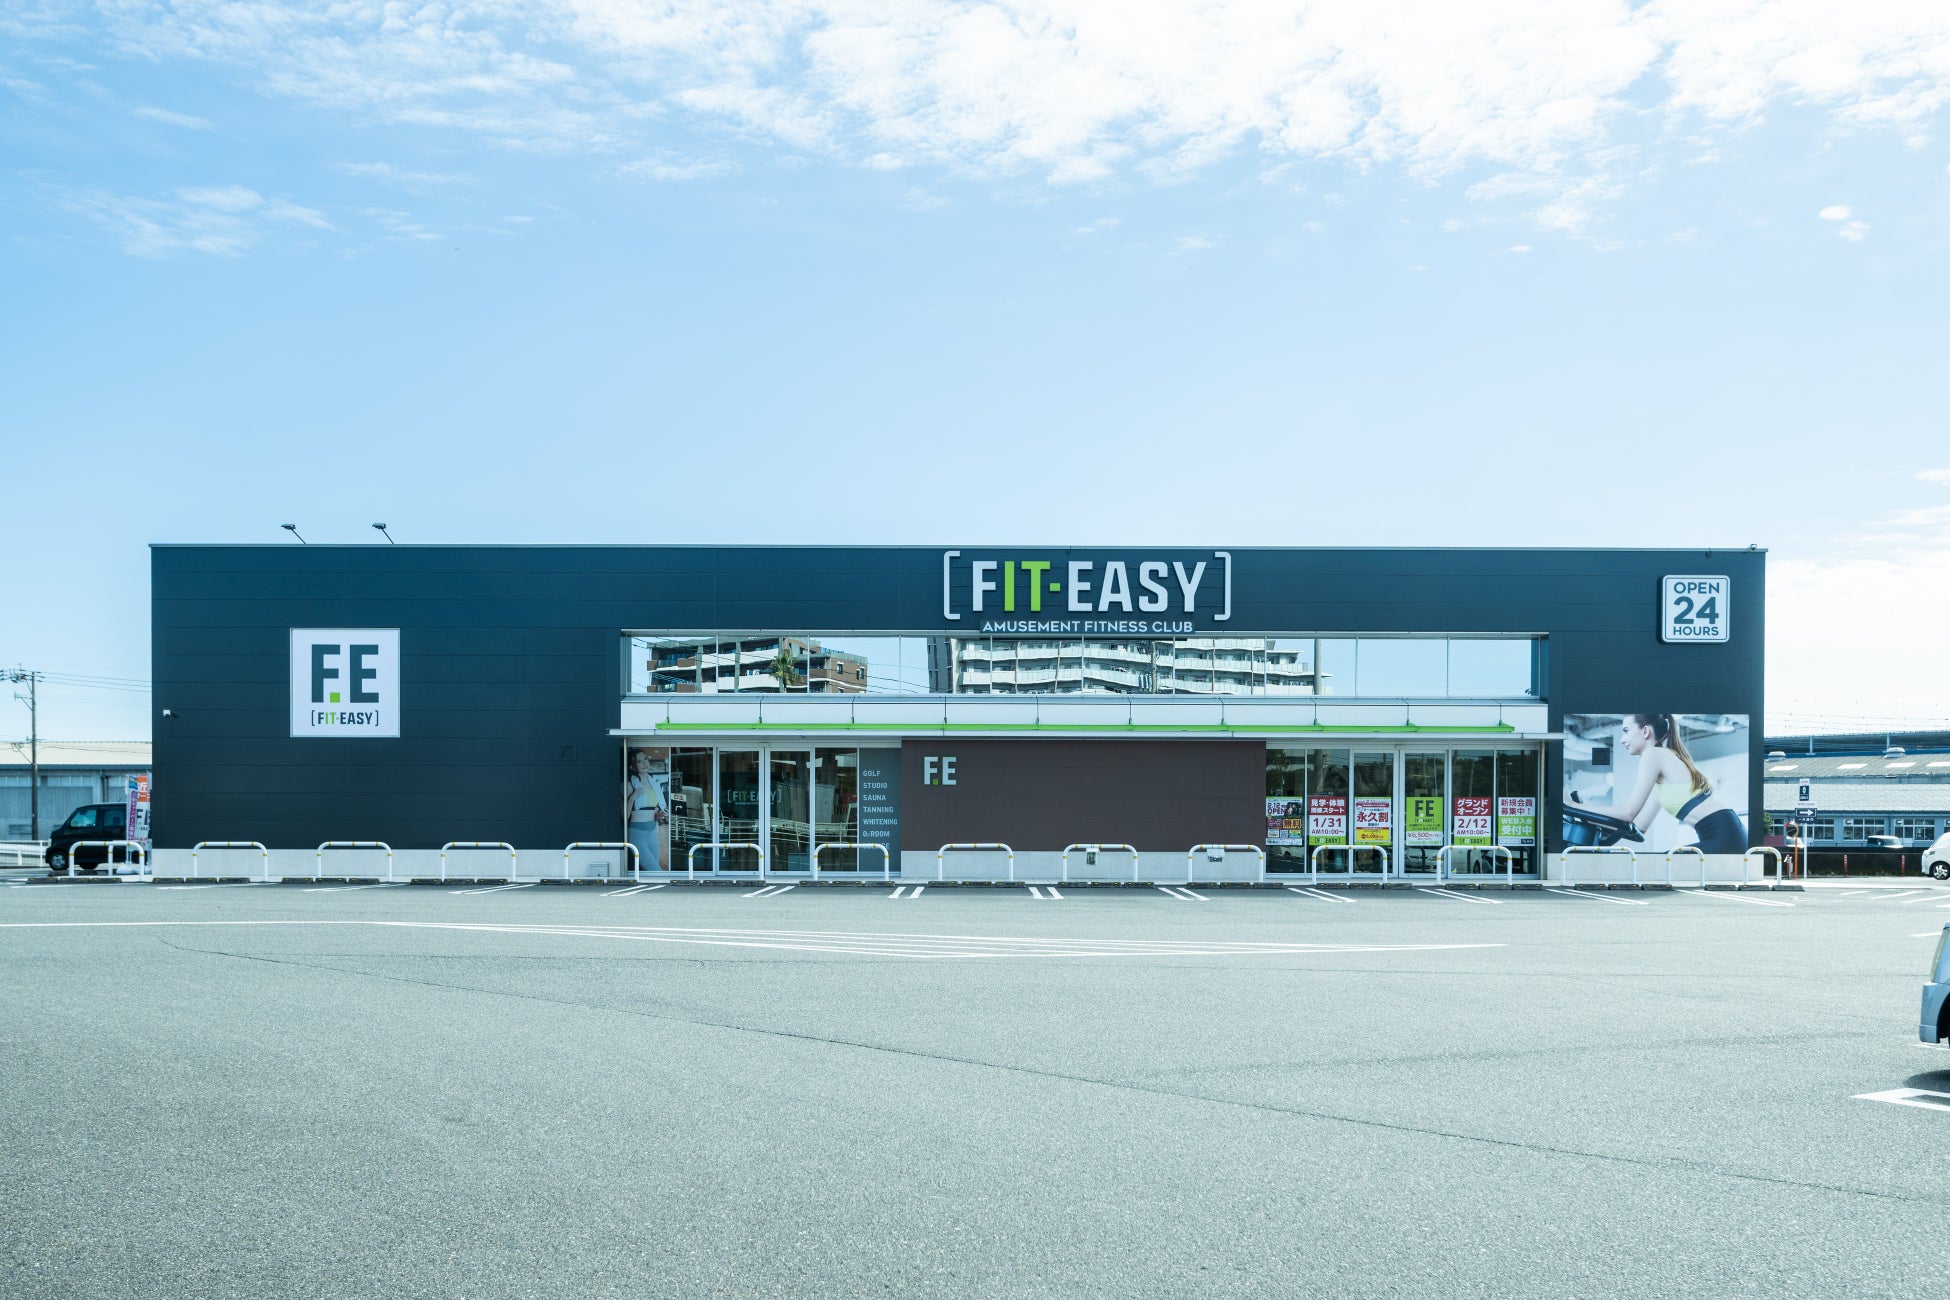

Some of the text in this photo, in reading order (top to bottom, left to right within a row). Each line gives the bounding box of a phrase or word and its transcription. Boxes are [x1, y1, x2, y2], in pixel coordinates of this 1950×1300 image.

[1673, 582, 1720, 594] OPEN
[1673, 596, 1719, 624] 24
[982, 620, 1193, 633] AMUSEMENT FITNESS CLUB
[1673, 626, 1719, 636] HOURS
[1457, 798, 1489, 807] グランド
[1501, 798, 1533, 807] 新規会員
[1457, 807, 1489, 815] オープン
[1313, 817, 1342, 828] 1/31
[1356, 811, 1389, 823] 永久割
[1457, 818, 1488, 829] 2/12
[1501, 825, 1533, 836] 受付中
